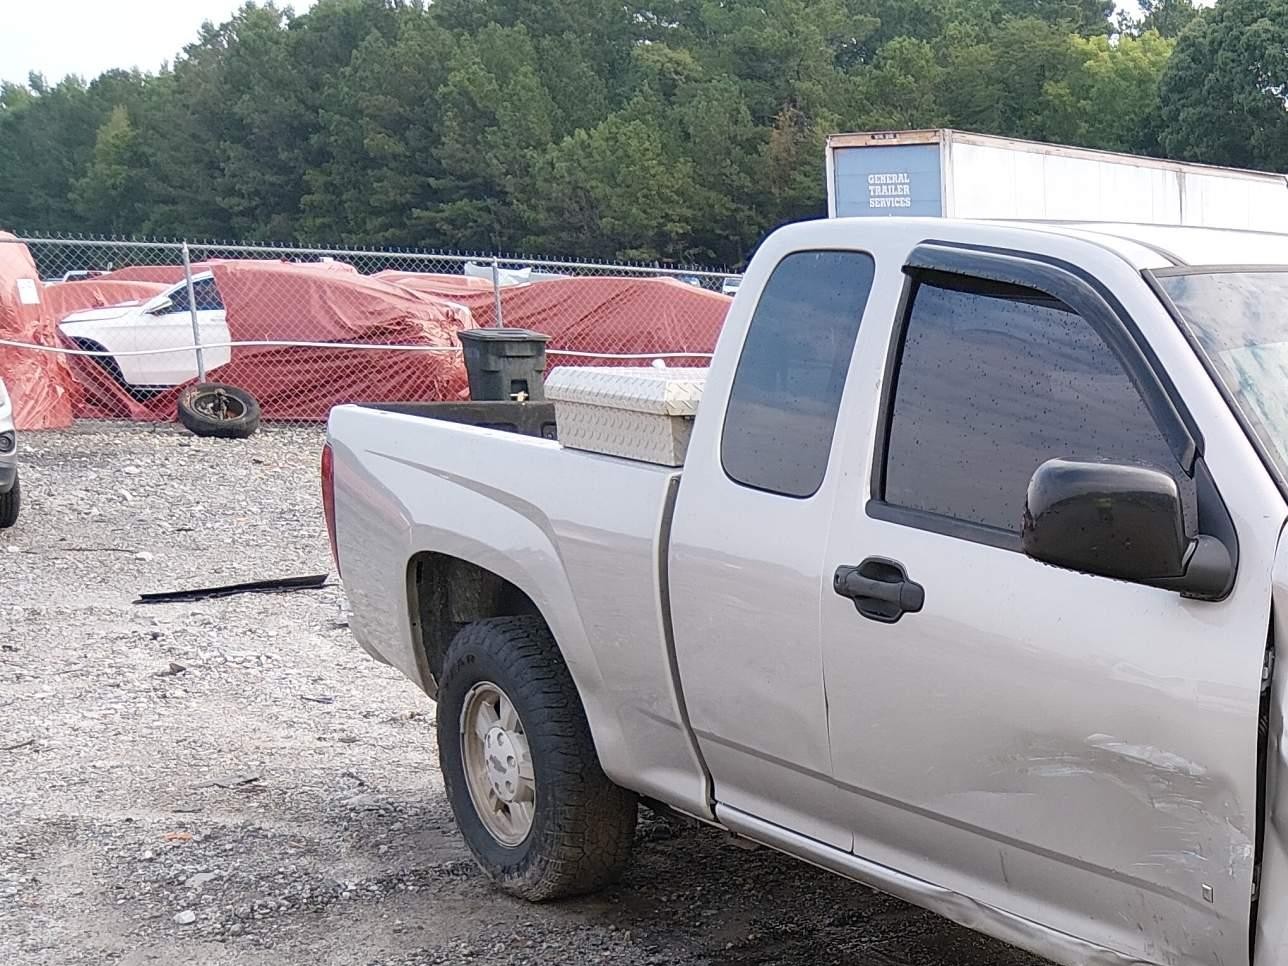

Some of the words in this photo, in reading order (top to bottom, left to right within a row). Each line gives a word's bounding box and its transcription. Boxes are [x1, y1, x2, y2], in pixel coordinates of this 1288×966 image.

[868, 173, 910, 184] GENERAL
[869, 185, 910, 195] TRAILER
[869, 197, 911, 208] SERVICES
